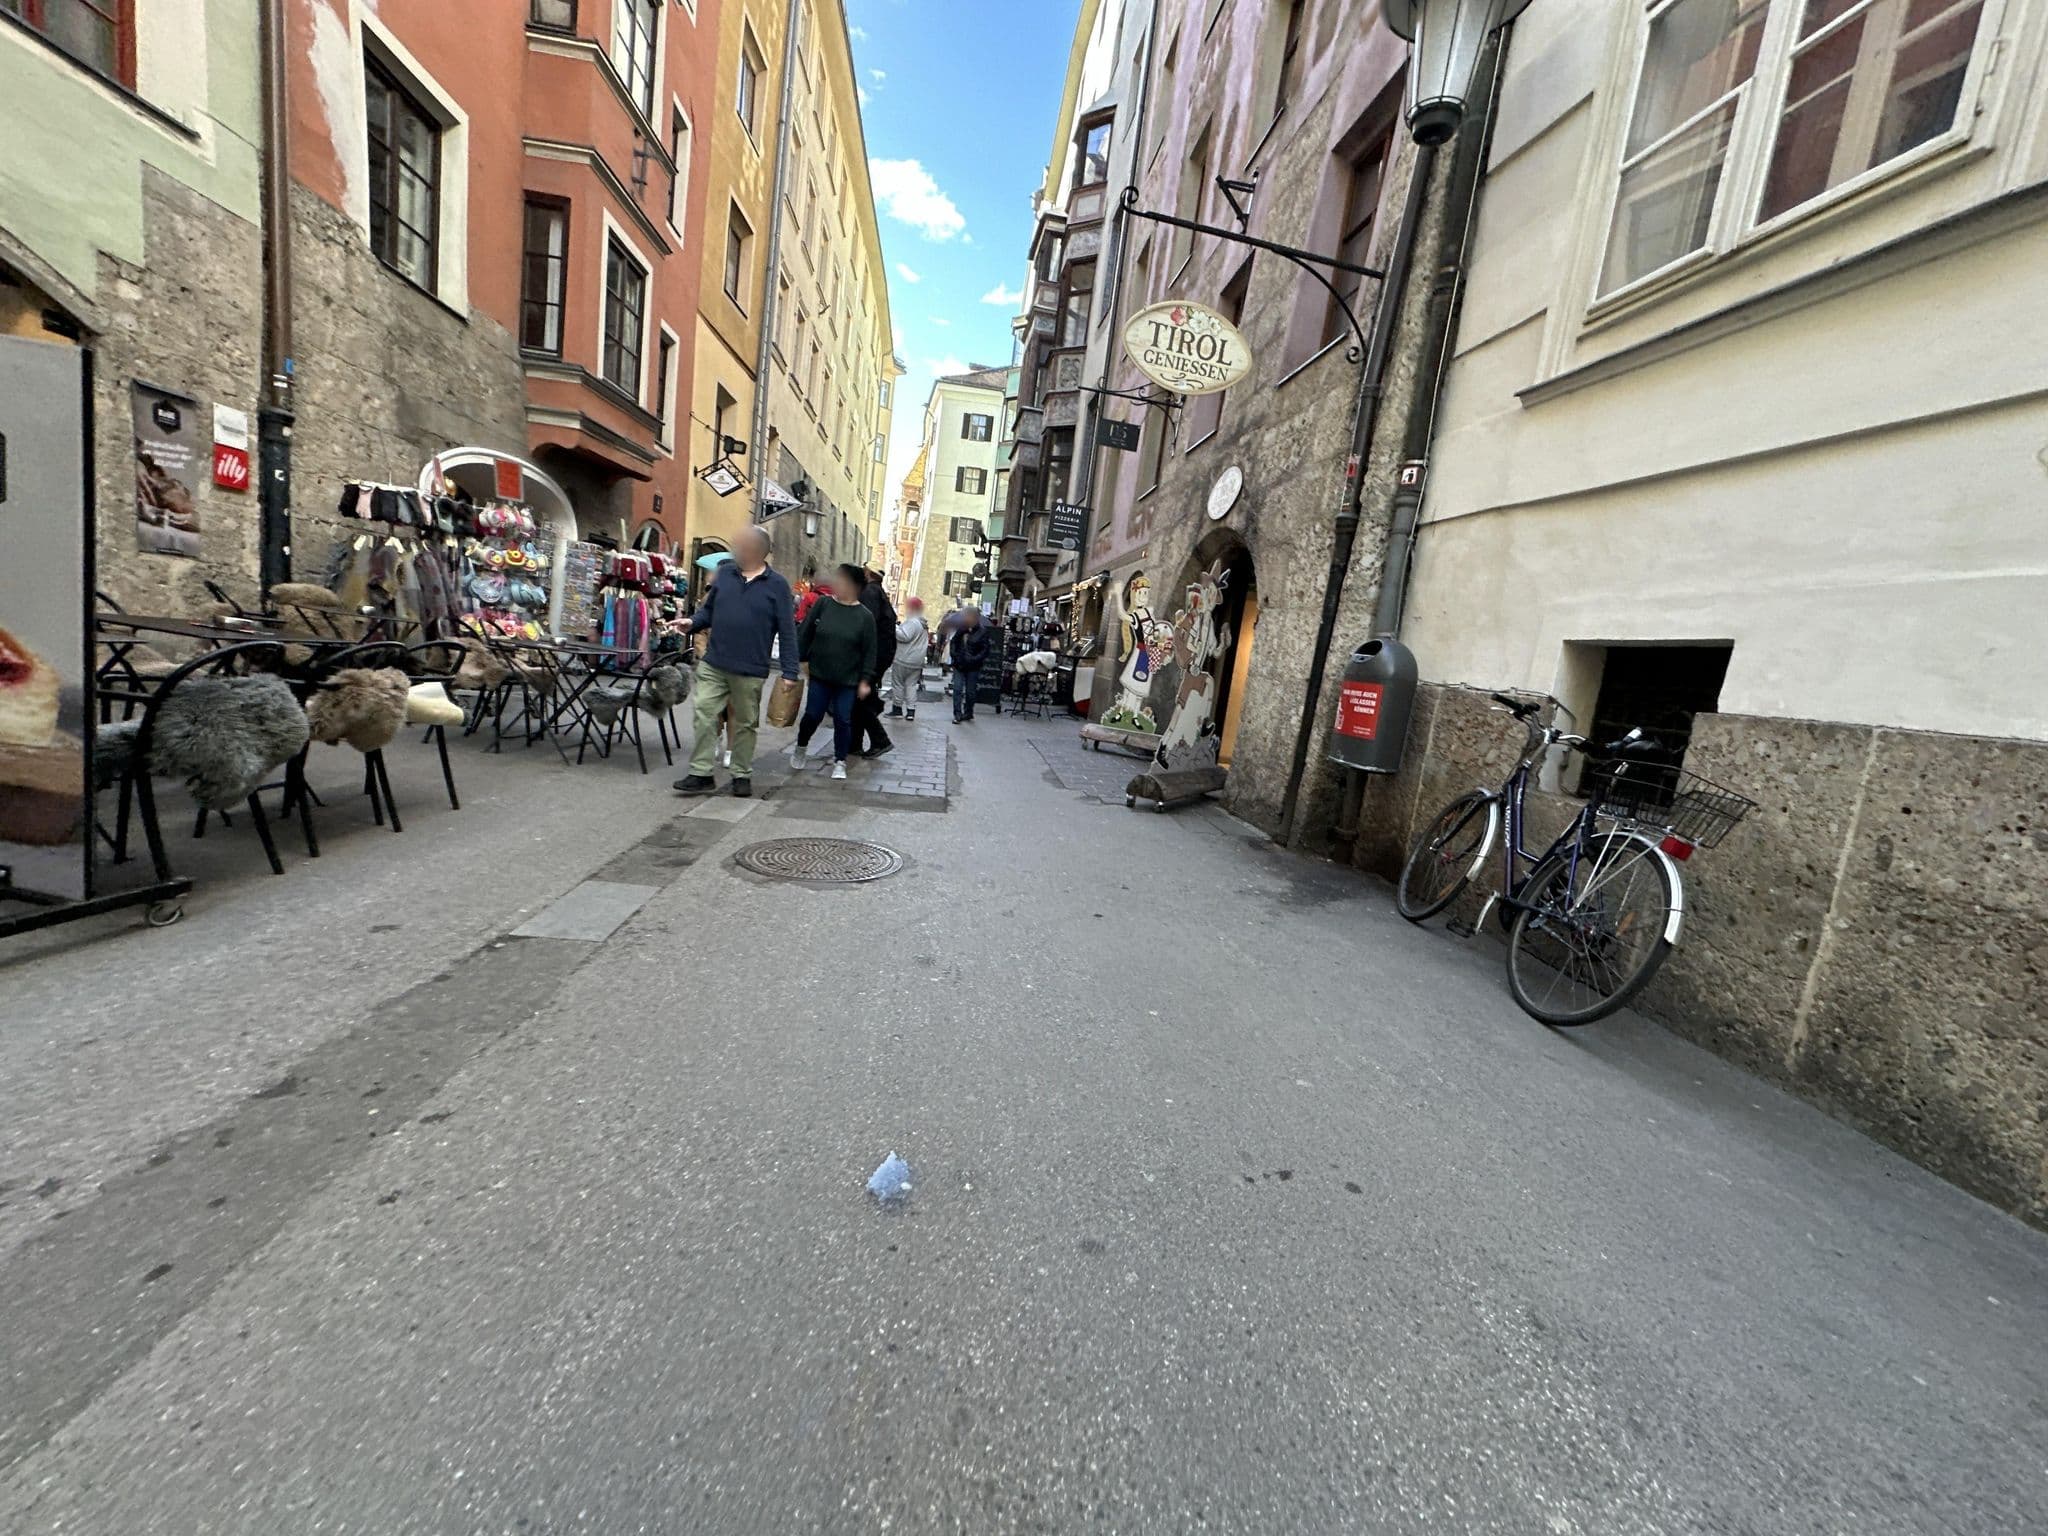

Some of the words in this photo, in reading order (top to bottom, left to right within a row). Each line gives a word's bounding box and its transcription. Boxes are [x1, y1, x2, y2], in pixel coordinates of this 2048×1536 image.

[1148, 320, 1232, 366] TIROL
[1143, 350, 1229, 382] GENIESSEN
[217, 453, 247, 484] illy
[1054, 515, 1080, 523] PIZZERIA
[1055, 504, 1082, 516] ALPIN
